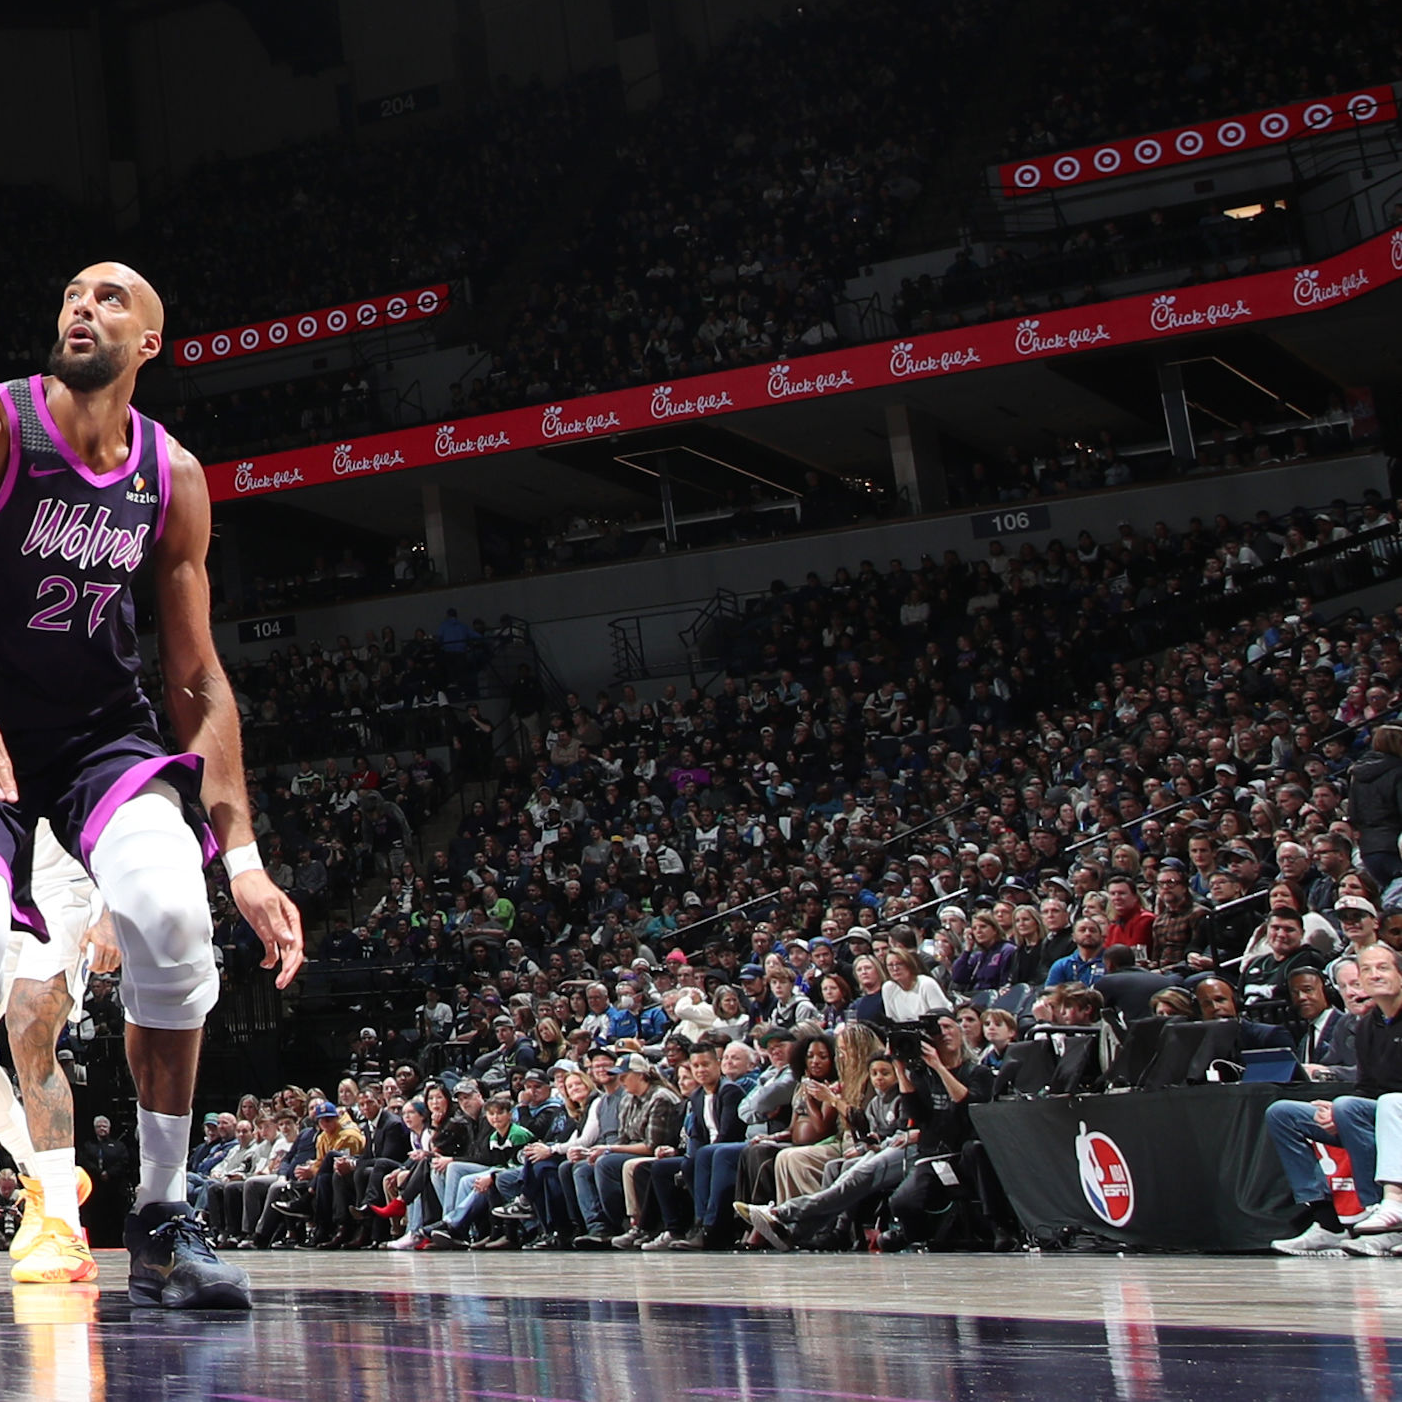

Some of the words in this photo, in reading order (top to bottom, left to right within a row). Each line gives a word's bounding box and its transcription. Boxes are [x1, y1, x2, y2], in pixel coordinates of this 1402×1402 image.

[380, 94, 414, 117] 204
[1292, 268, 1370, 307] Chick-fil-A
[1150, 294, 1252, 332] Chick-fil-A
[1015, 319, 1111, 356] Chick-fil-A
[890, 342, 981, 377] Chick-fil-A
[767, 364, 854, 399] Chick-fil-A
[650, 385, 733, 419] Chick-fil-A
[541, 405, 620, 438] Chick-fil-A
[434, 425, 510, 457] Chick-fil-A
[332, 443, 405, 475] Chick-fil-A
[234, 461, 304, 493] Chick-fil-A
[125, 490, 159, 504] sezzle
[20, 497, 151, 573] Wolves
[992, 512, 1029, 532] 106
[27, 574, 122, 639] 27
[253, 621, 282, 638] 104
